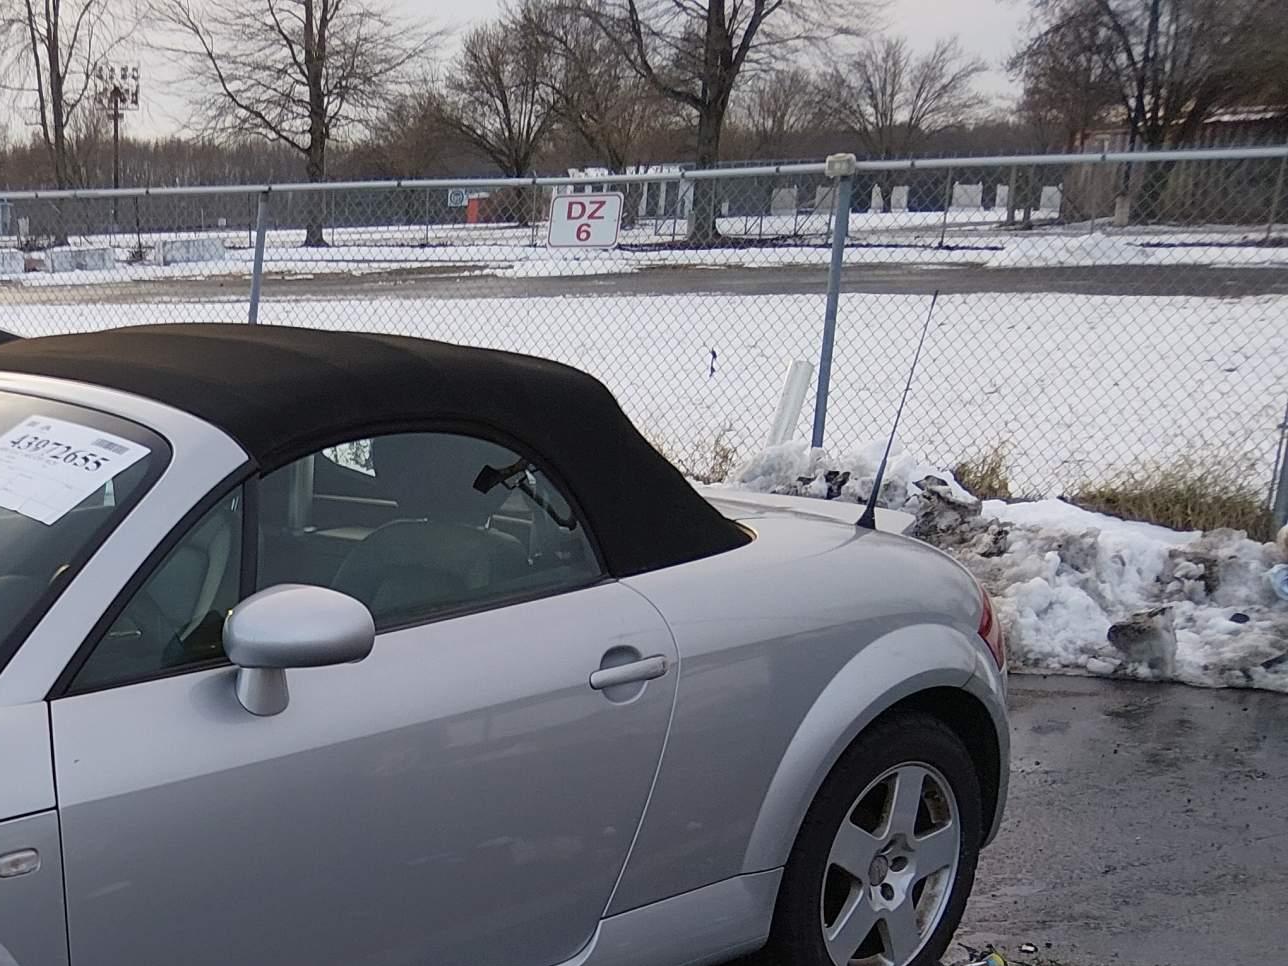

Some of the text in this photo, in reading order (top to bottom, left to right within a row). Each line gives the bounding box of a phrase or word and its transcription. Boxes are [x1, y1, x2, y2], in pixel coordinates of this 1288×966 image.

[566, 200, 607, 221] DZ
[576, 222, 592, 242] 6
[9, 434, 110, 472] 43972655
